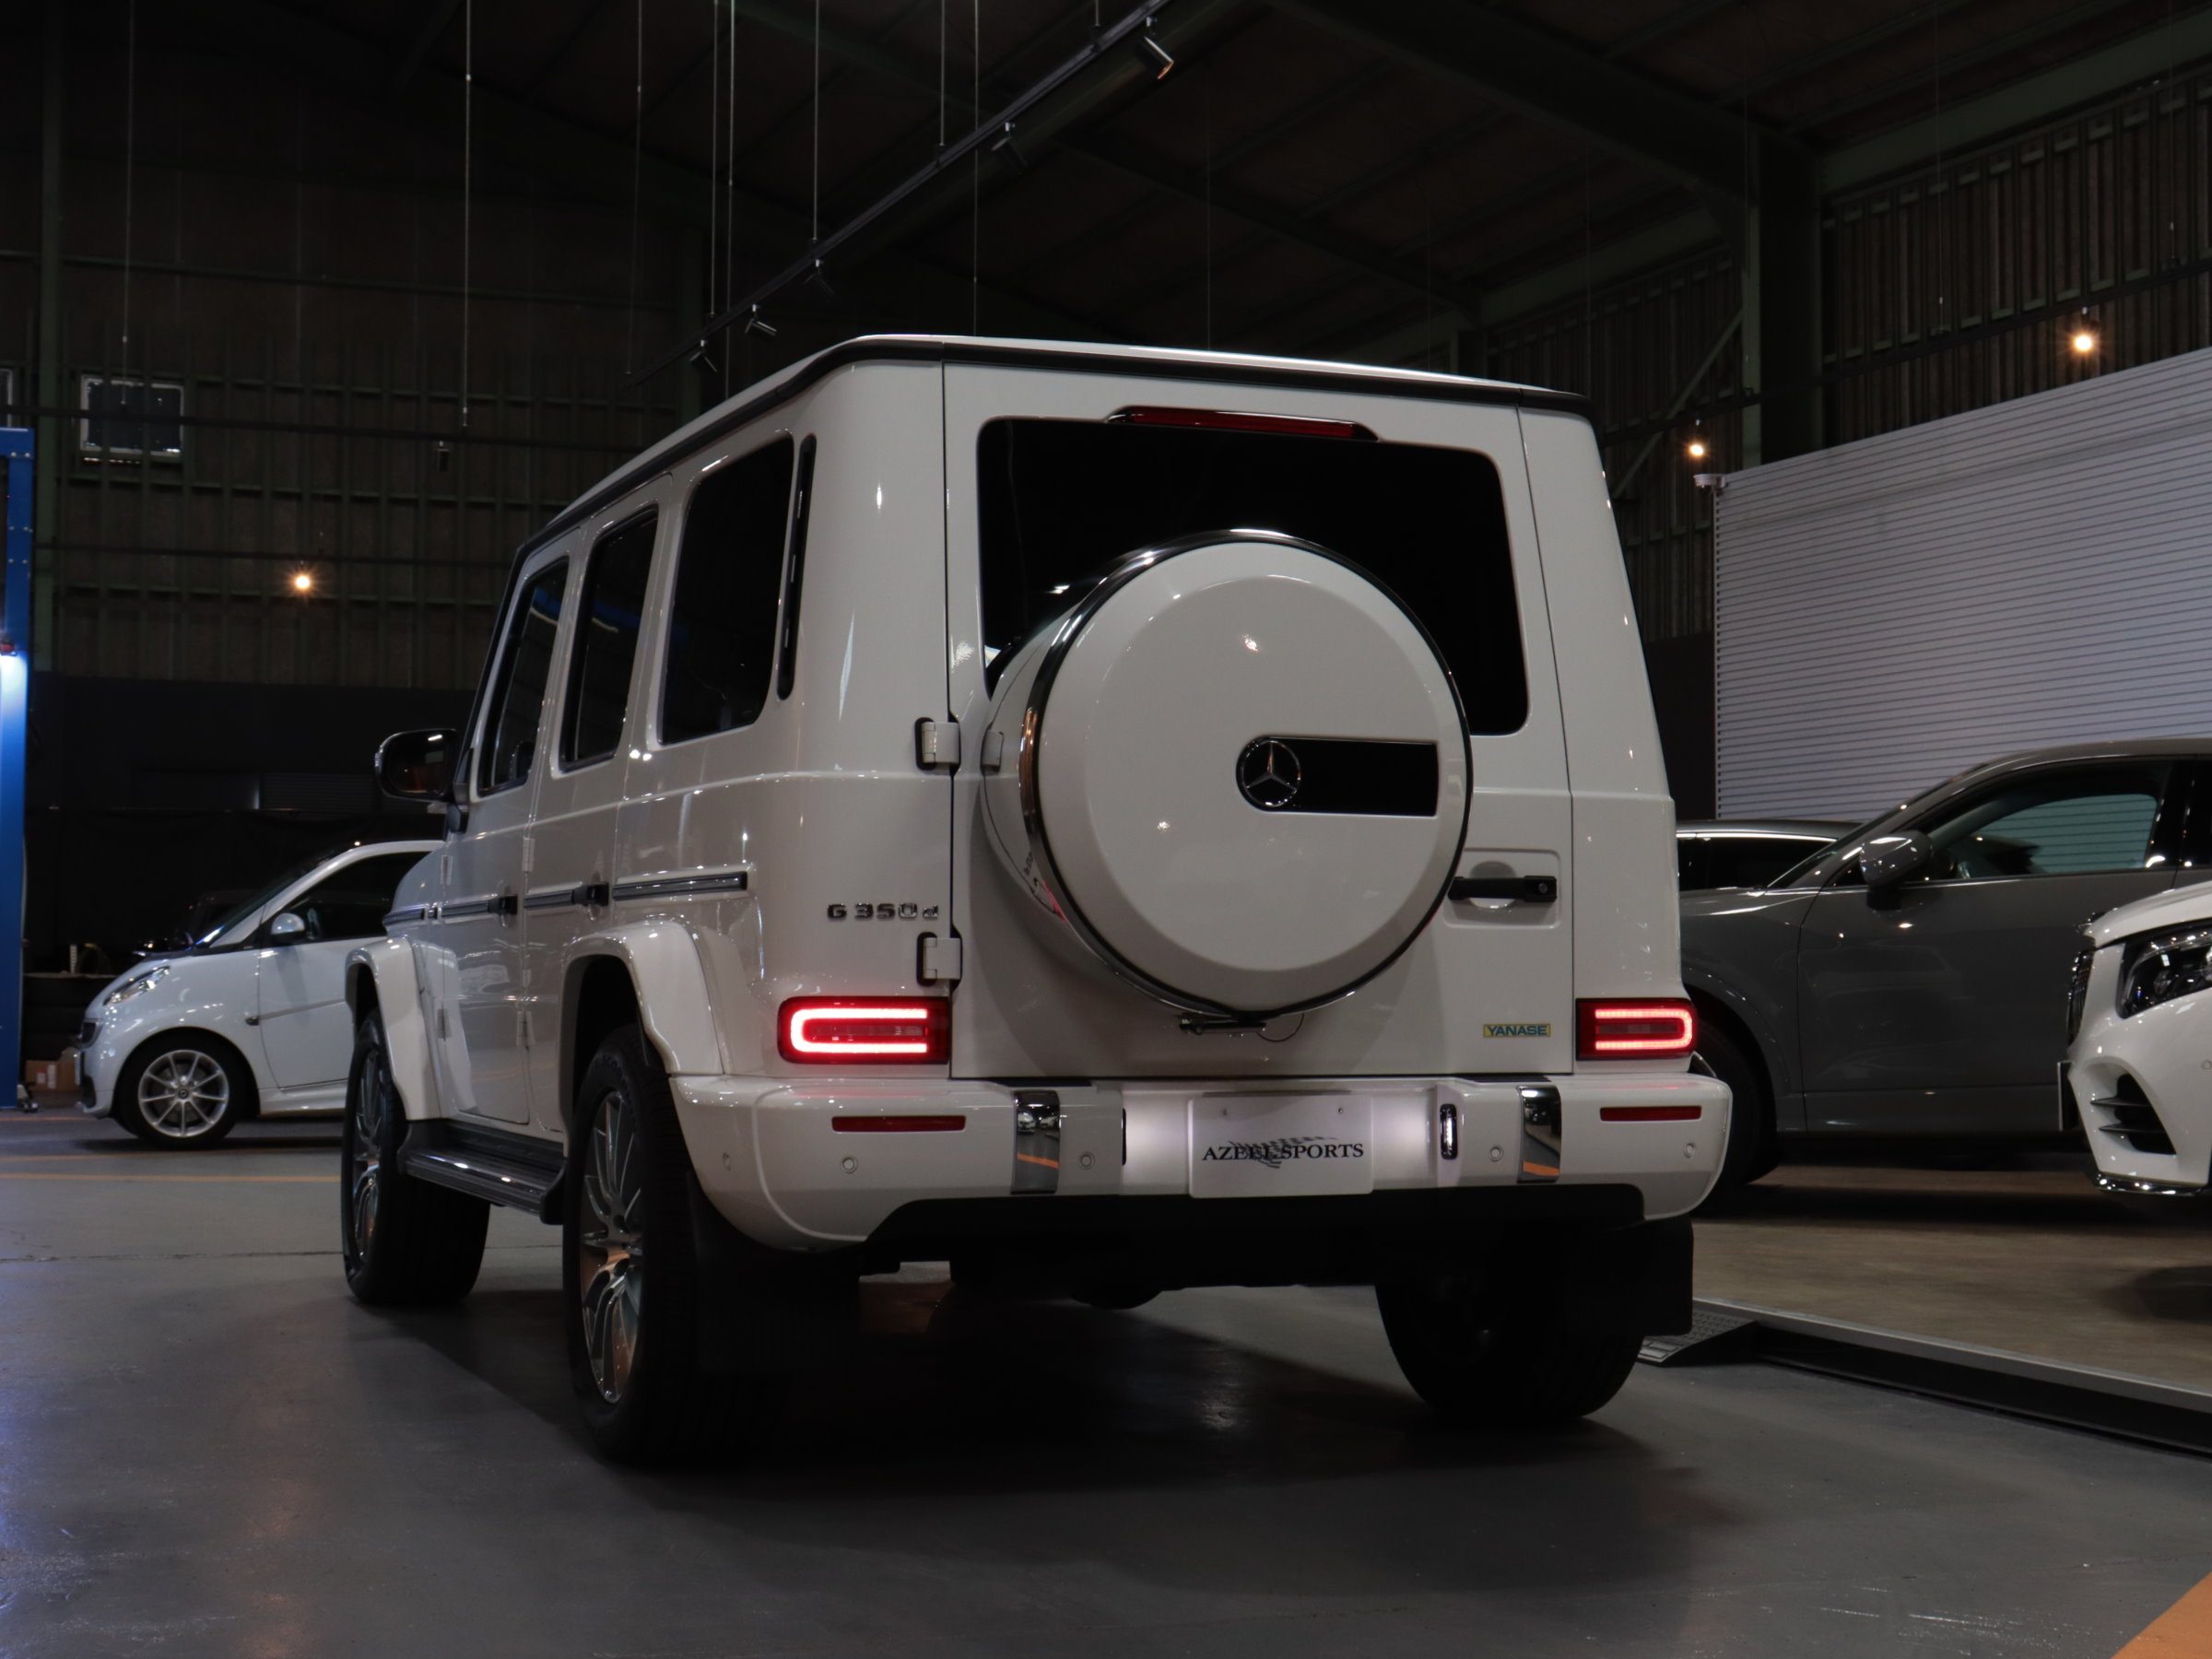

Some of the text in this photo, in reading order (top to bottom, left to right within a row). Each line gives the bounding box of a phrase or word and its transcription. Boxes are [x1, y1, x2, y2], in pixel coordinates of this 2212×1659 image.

[828, 903, 847, 920] G
[1487, 1024, 1547, 1037] YANASE
[1282, 1143, 1365, 1159] SPORTS
